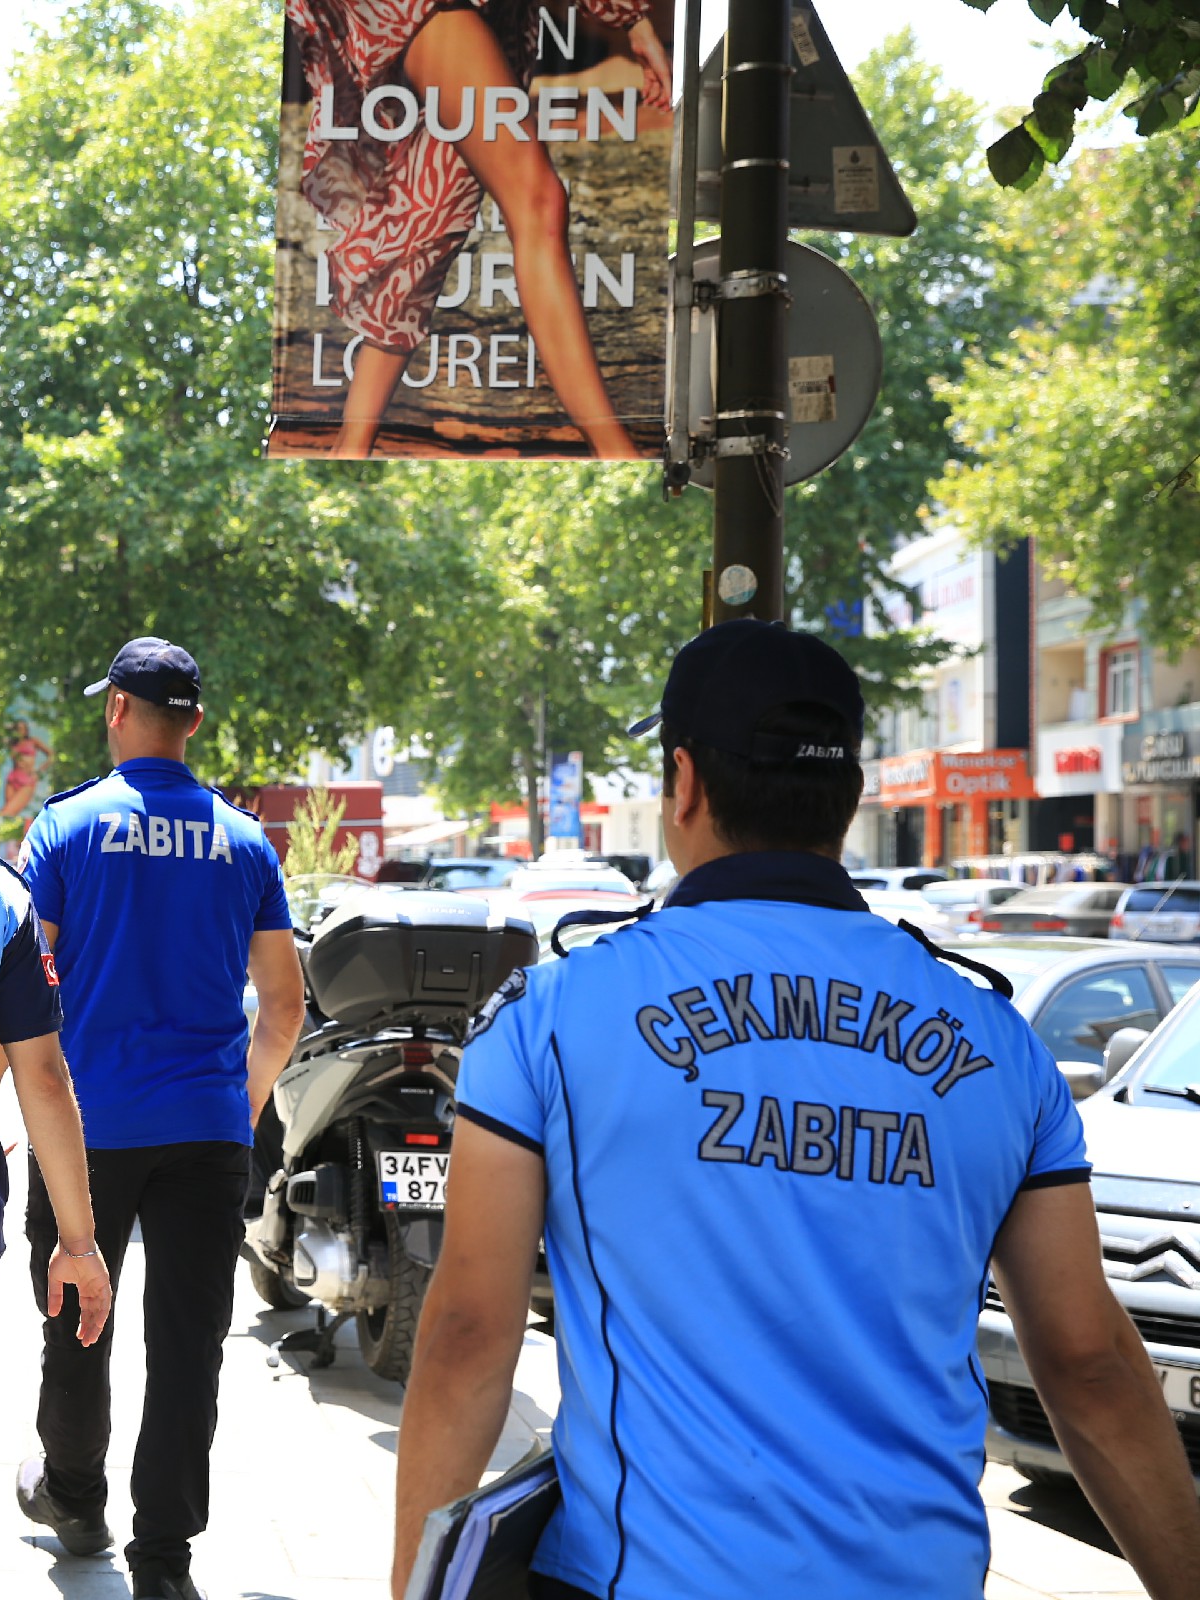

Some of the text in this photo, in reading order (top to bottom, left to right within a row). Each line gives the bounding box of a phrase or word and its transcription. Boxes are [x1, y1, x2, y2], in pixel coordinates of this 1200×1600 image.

[319, 84, 637, 142] LOUREN
[315, 252, 635, 309] LURN
[168, 697, 191, 707] ZABITA
[796, 744, 844, 759] ZABITA
[99, 812, 234, 865] ZABITA
[635, 973, 994, 1098] ÇEKMEKÖY
[700, 1090, 935, 1188] ZABITA
[408, 1181, 448, 1201] 87
